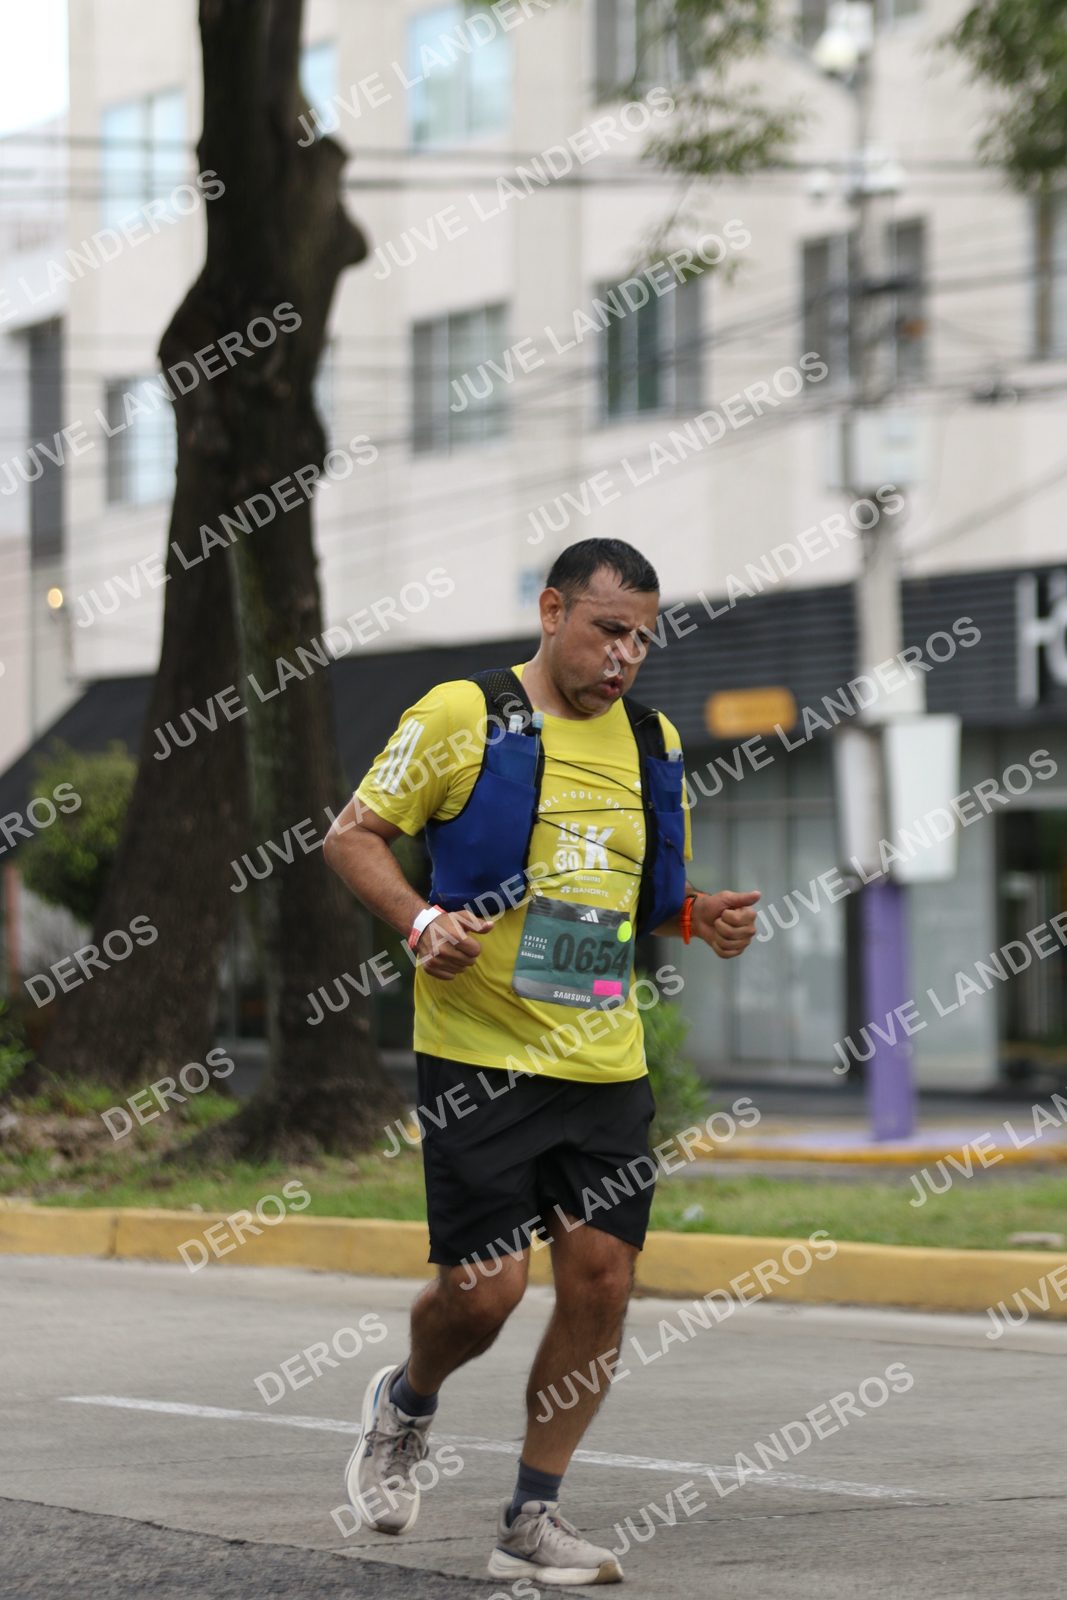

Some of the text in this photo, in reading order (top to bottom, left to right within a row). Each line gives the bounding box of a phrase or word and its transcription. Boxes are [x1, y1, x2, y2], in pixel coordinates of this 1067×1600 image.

[558, 822, 580, 843] 15
[583, 825, 615, 869] K
[555, 849, 580, 873] 30
[521, 951, 544, 960] SAMSUNG
[552, 933, 631, 979] 0654
[553, 990, 591, 1003] SAMSUNG
